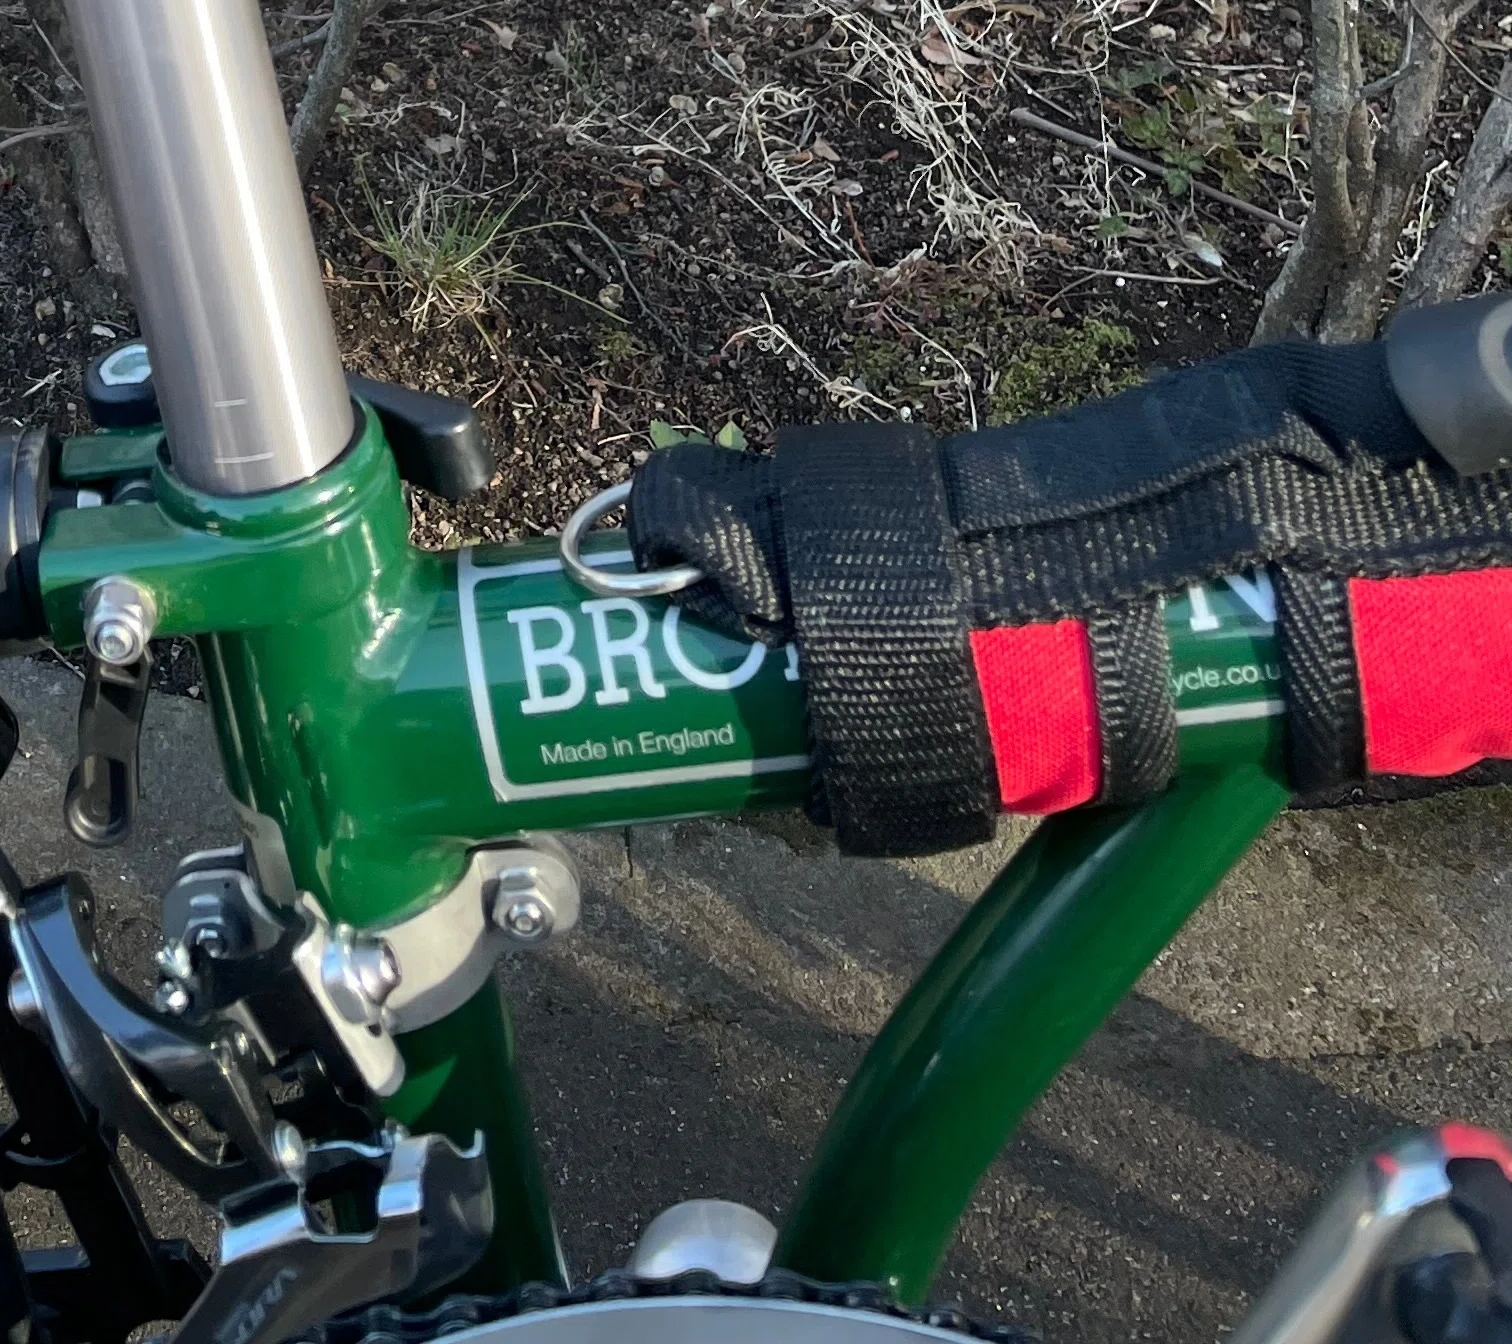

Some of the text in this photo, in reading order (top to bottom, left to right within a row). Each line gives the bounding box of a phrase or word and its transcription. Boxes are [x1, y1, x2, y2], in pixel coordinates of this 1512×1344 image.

[541, 722, 735, 765] Made in England
